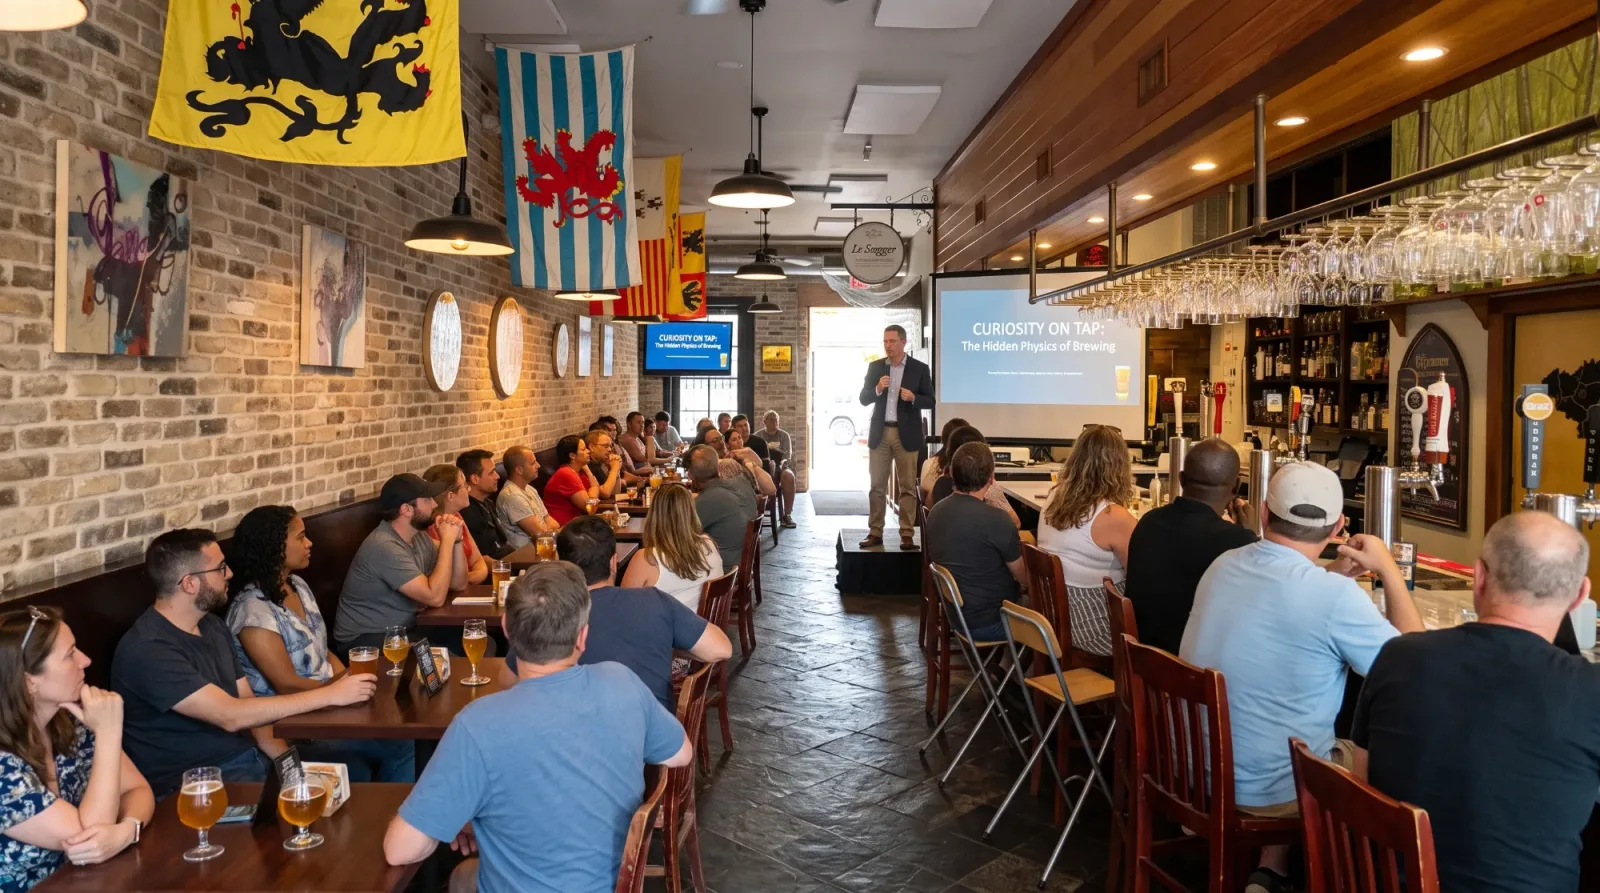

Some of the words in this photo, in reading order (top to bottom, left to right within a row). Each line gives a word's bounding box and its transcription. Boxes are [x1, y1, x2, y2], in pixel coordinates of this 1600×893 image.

[851, 244, 862, 253] Le
[972, 322, 1045, 336] CURIOSITY
[1048, 322, 1070, 336] ON
[1073, 322, 1105, 336] TAP:
[659, 334, 693, 342] CURIOSITY
[693, 334, 703, 342] ON
[961, 341, 981, 352] The
[983, 341, 1018, 352] Hidden
[1021, 341, 1057, 354] Physics
[1059, 341, 1071, 352] of
[1073, 341, 1116, 354] Brewing
